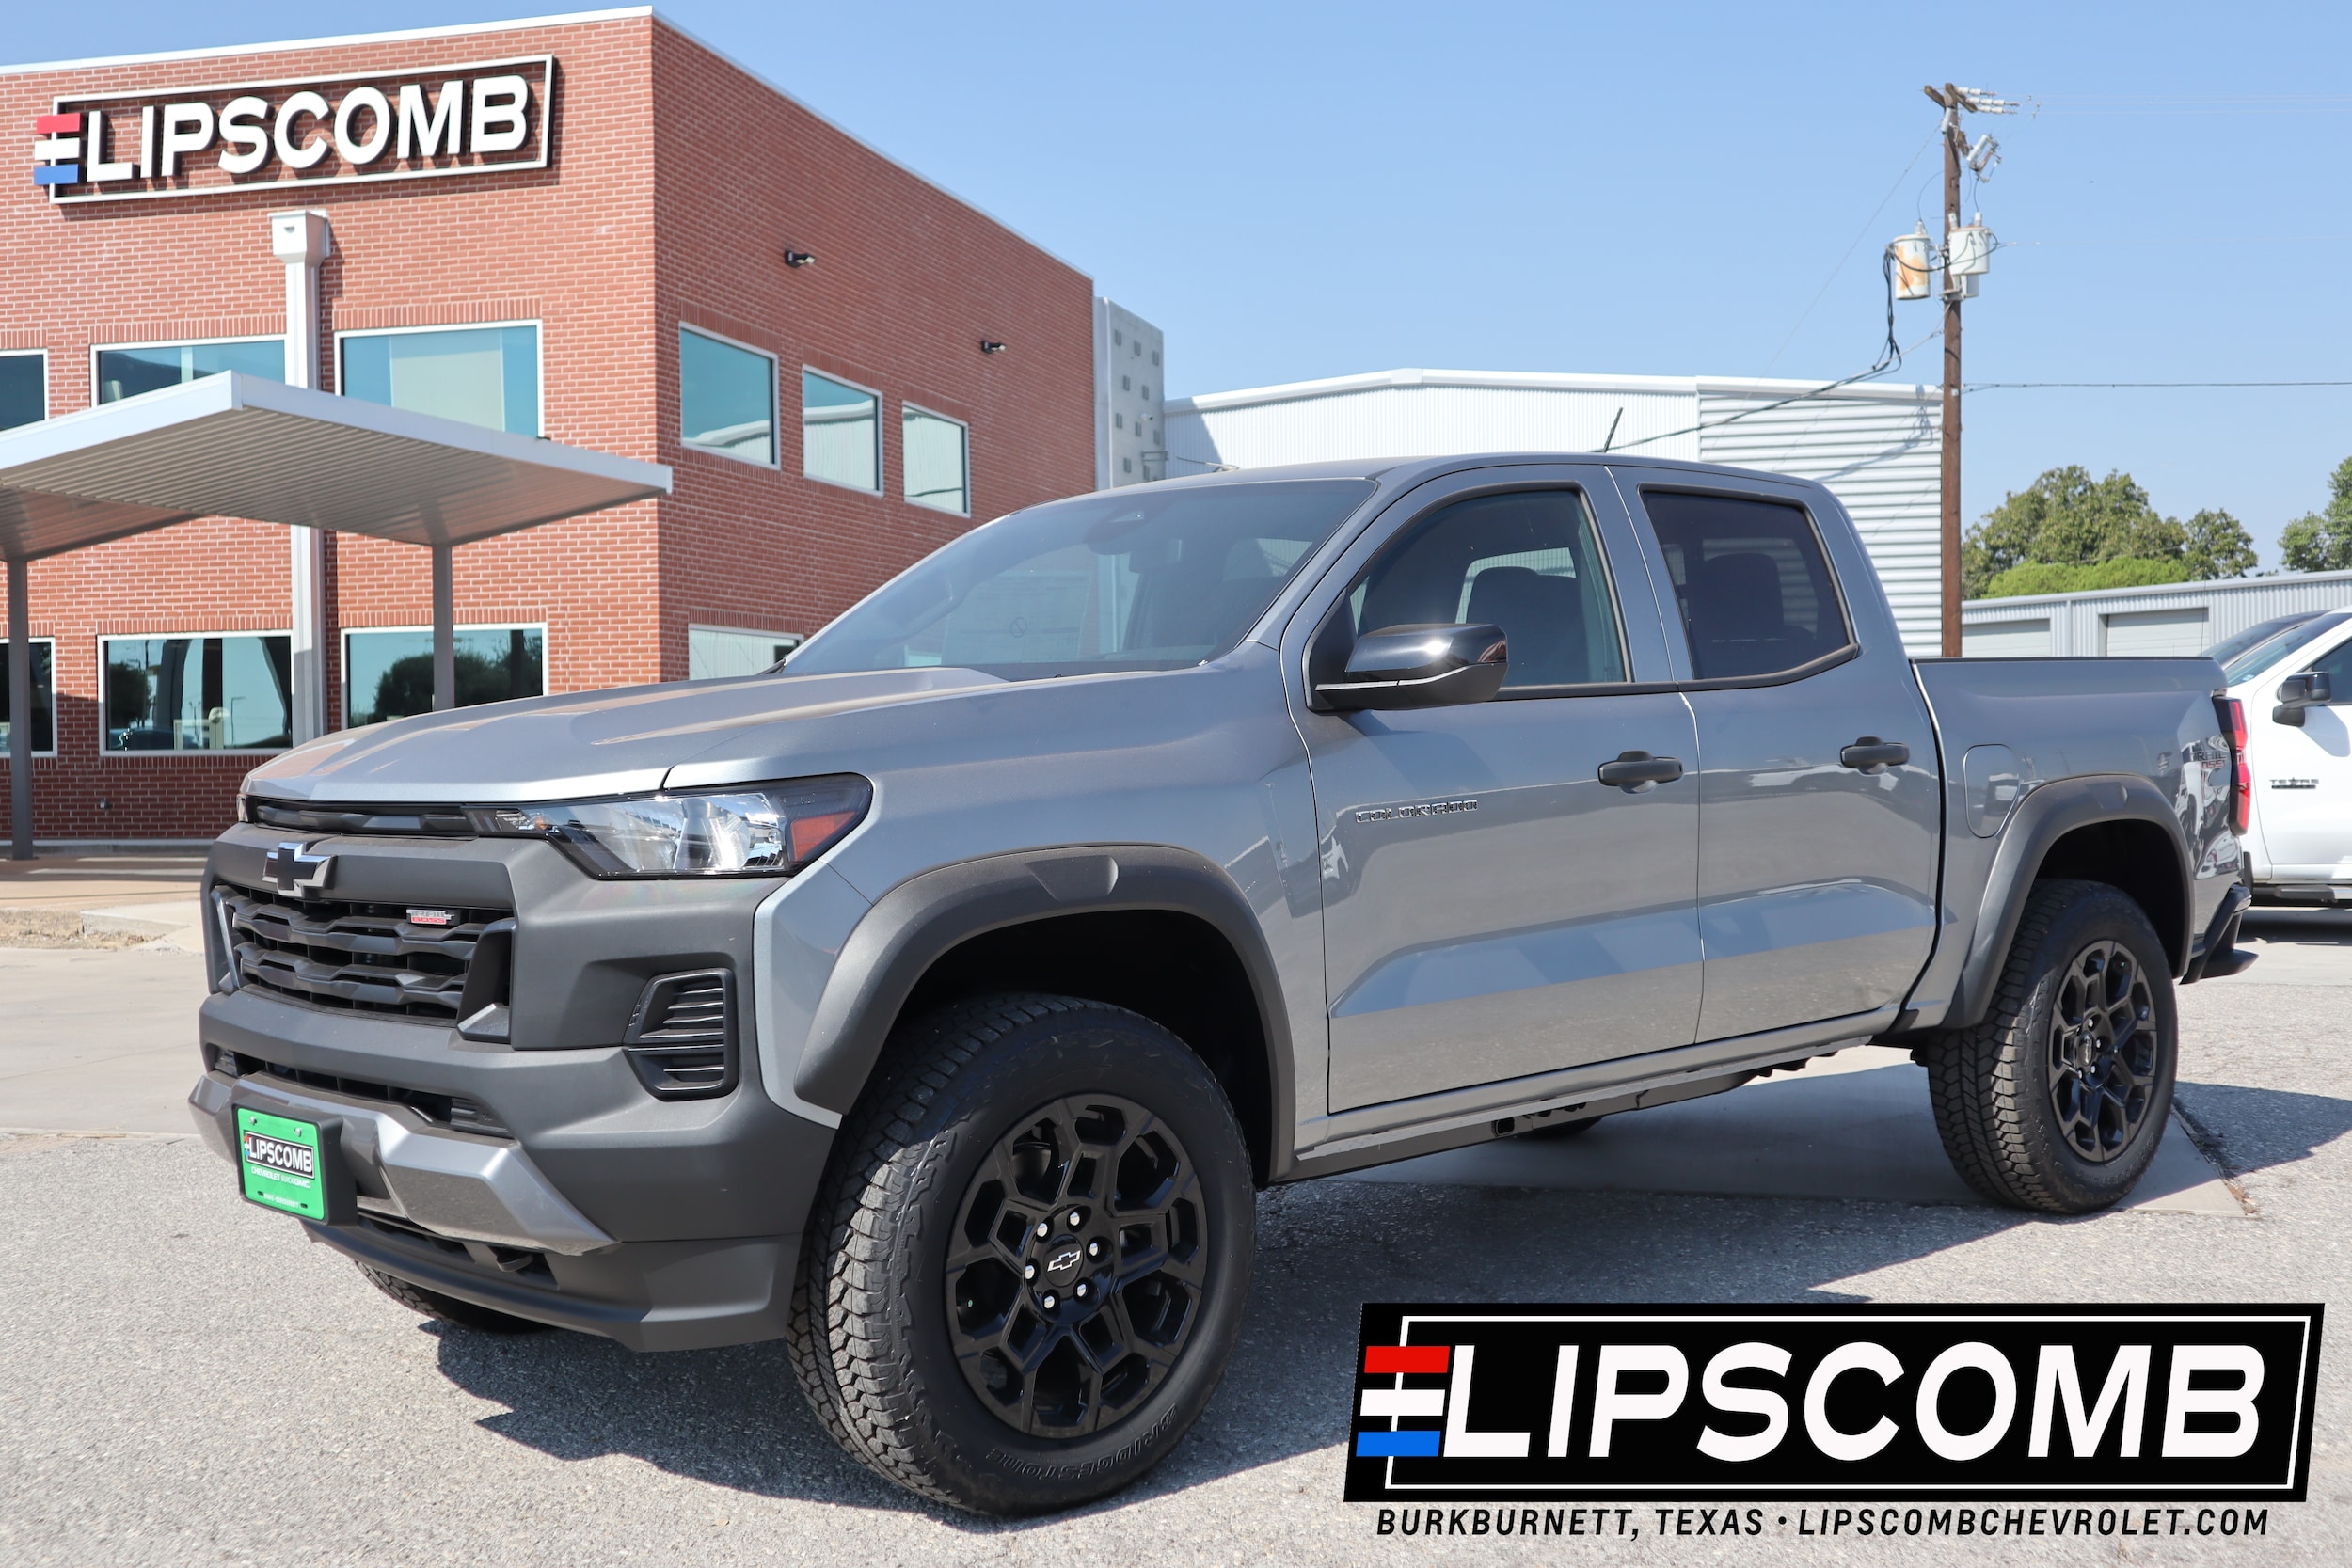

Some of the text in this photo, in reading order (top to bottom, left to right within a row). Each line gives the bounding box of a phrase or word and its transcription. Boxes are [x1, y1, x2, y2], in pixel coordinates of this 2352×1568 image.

[87, 74, 528, 182] LIPSCOMB
[1355, 800, 1478, 824] COLORADO
[248, 1136, 313, 1173] LIPSCOMB
